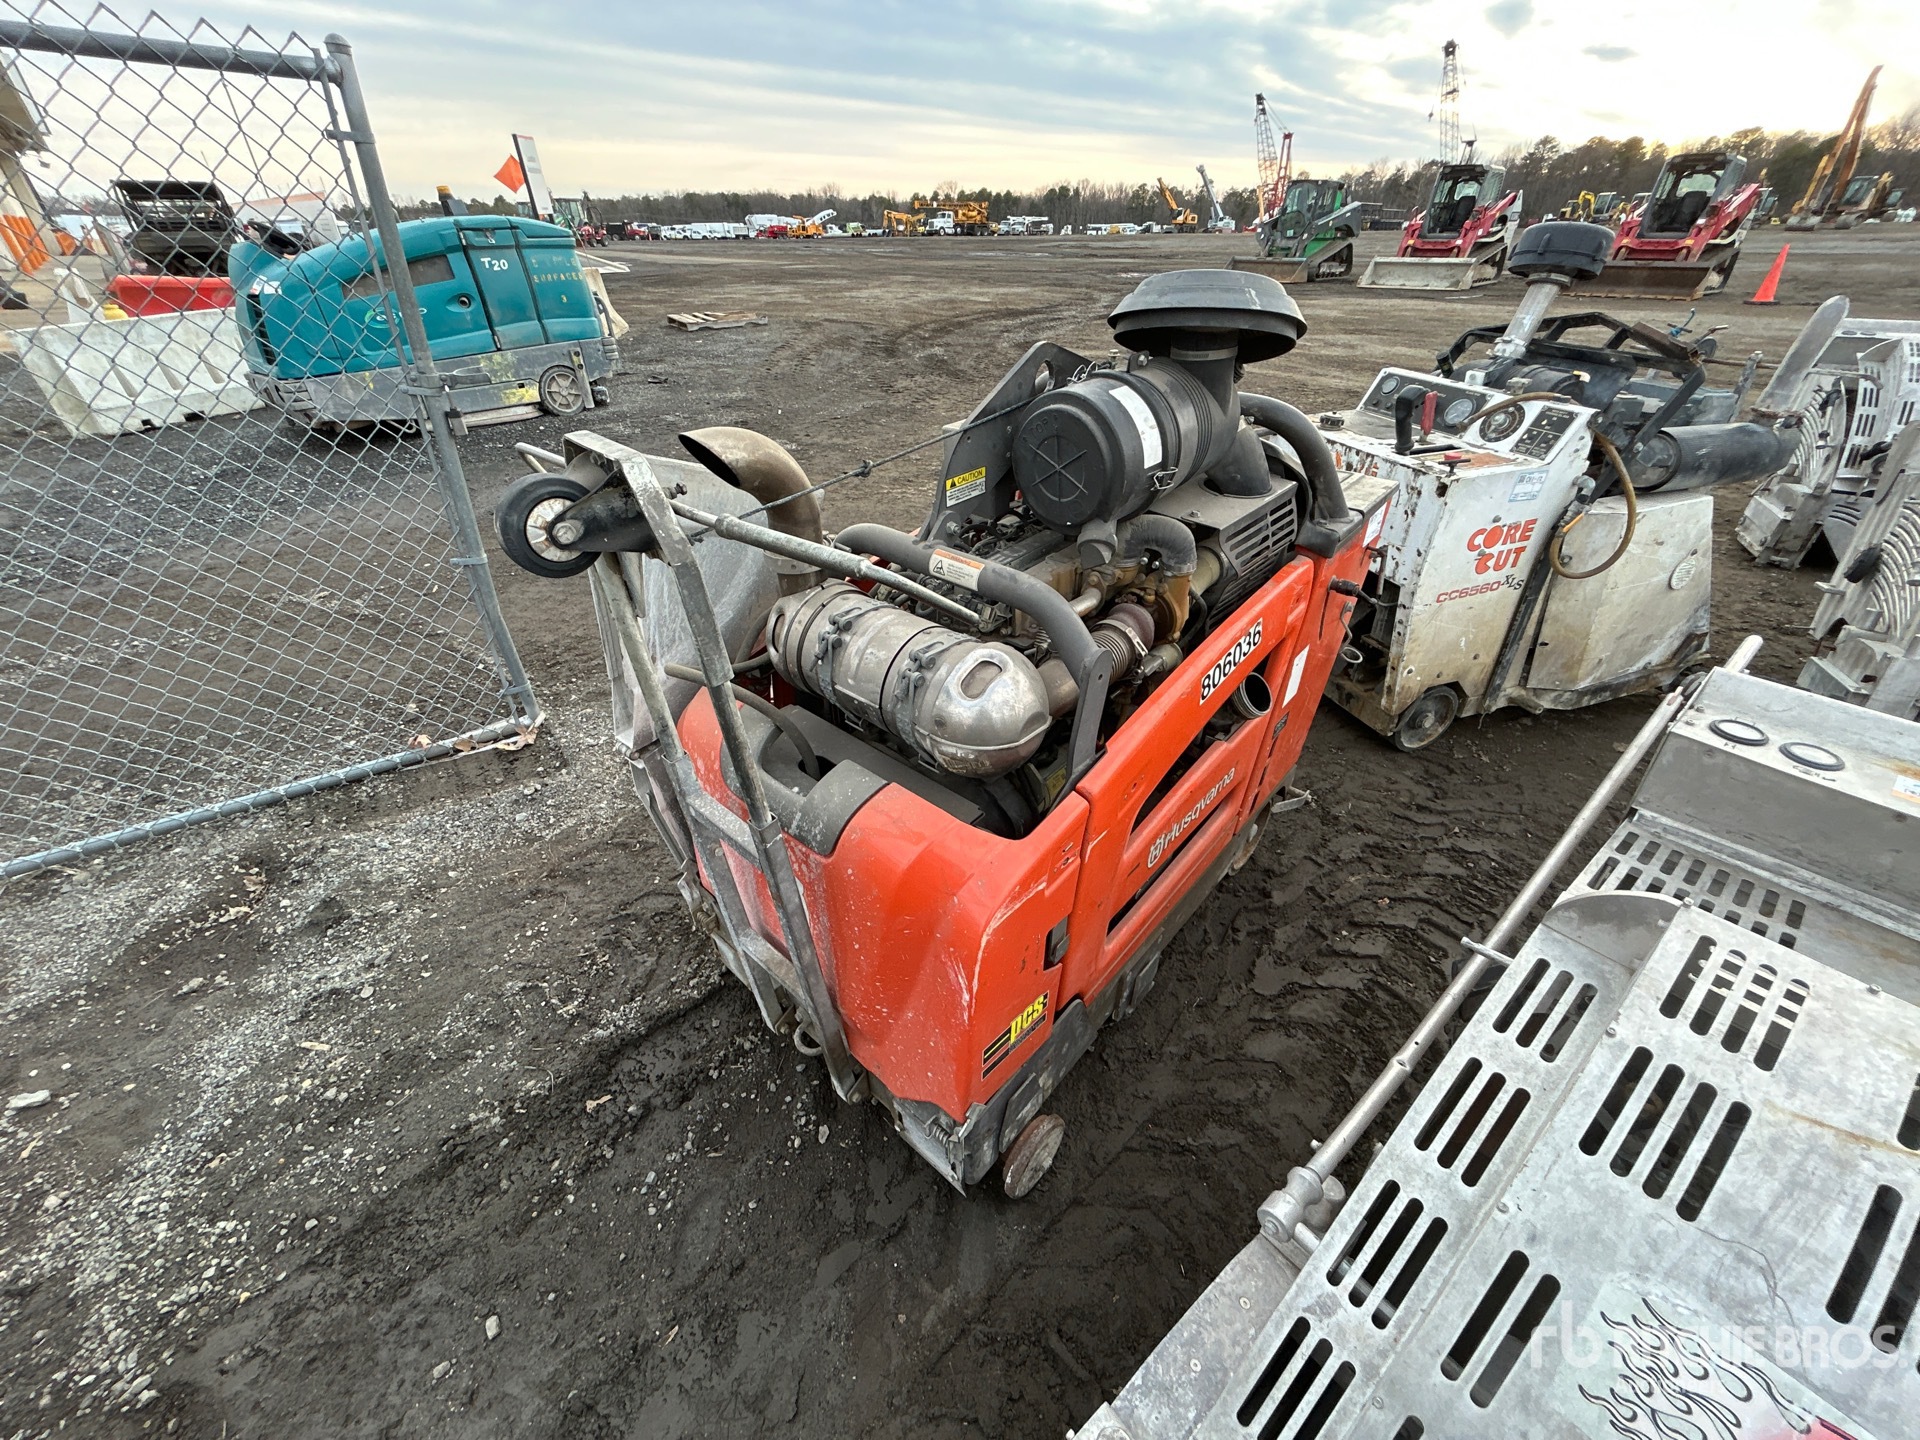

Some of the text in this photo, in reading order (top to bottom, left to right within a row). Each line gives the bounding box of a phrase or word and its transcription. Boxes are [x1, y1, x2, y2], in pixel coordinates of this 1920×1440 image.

[480, 257, 509, 271] T20
[957, 469, 983, 484] CAUTION
[1467, 518, 1538, 552] CORE
[1475, 546, 1528, 575] CUT
[1436, 580, 1502, 604] CC6560
[1201, 620, 1262, 701] 806036
[1164, 767, 1236, 850] Husqvarna
